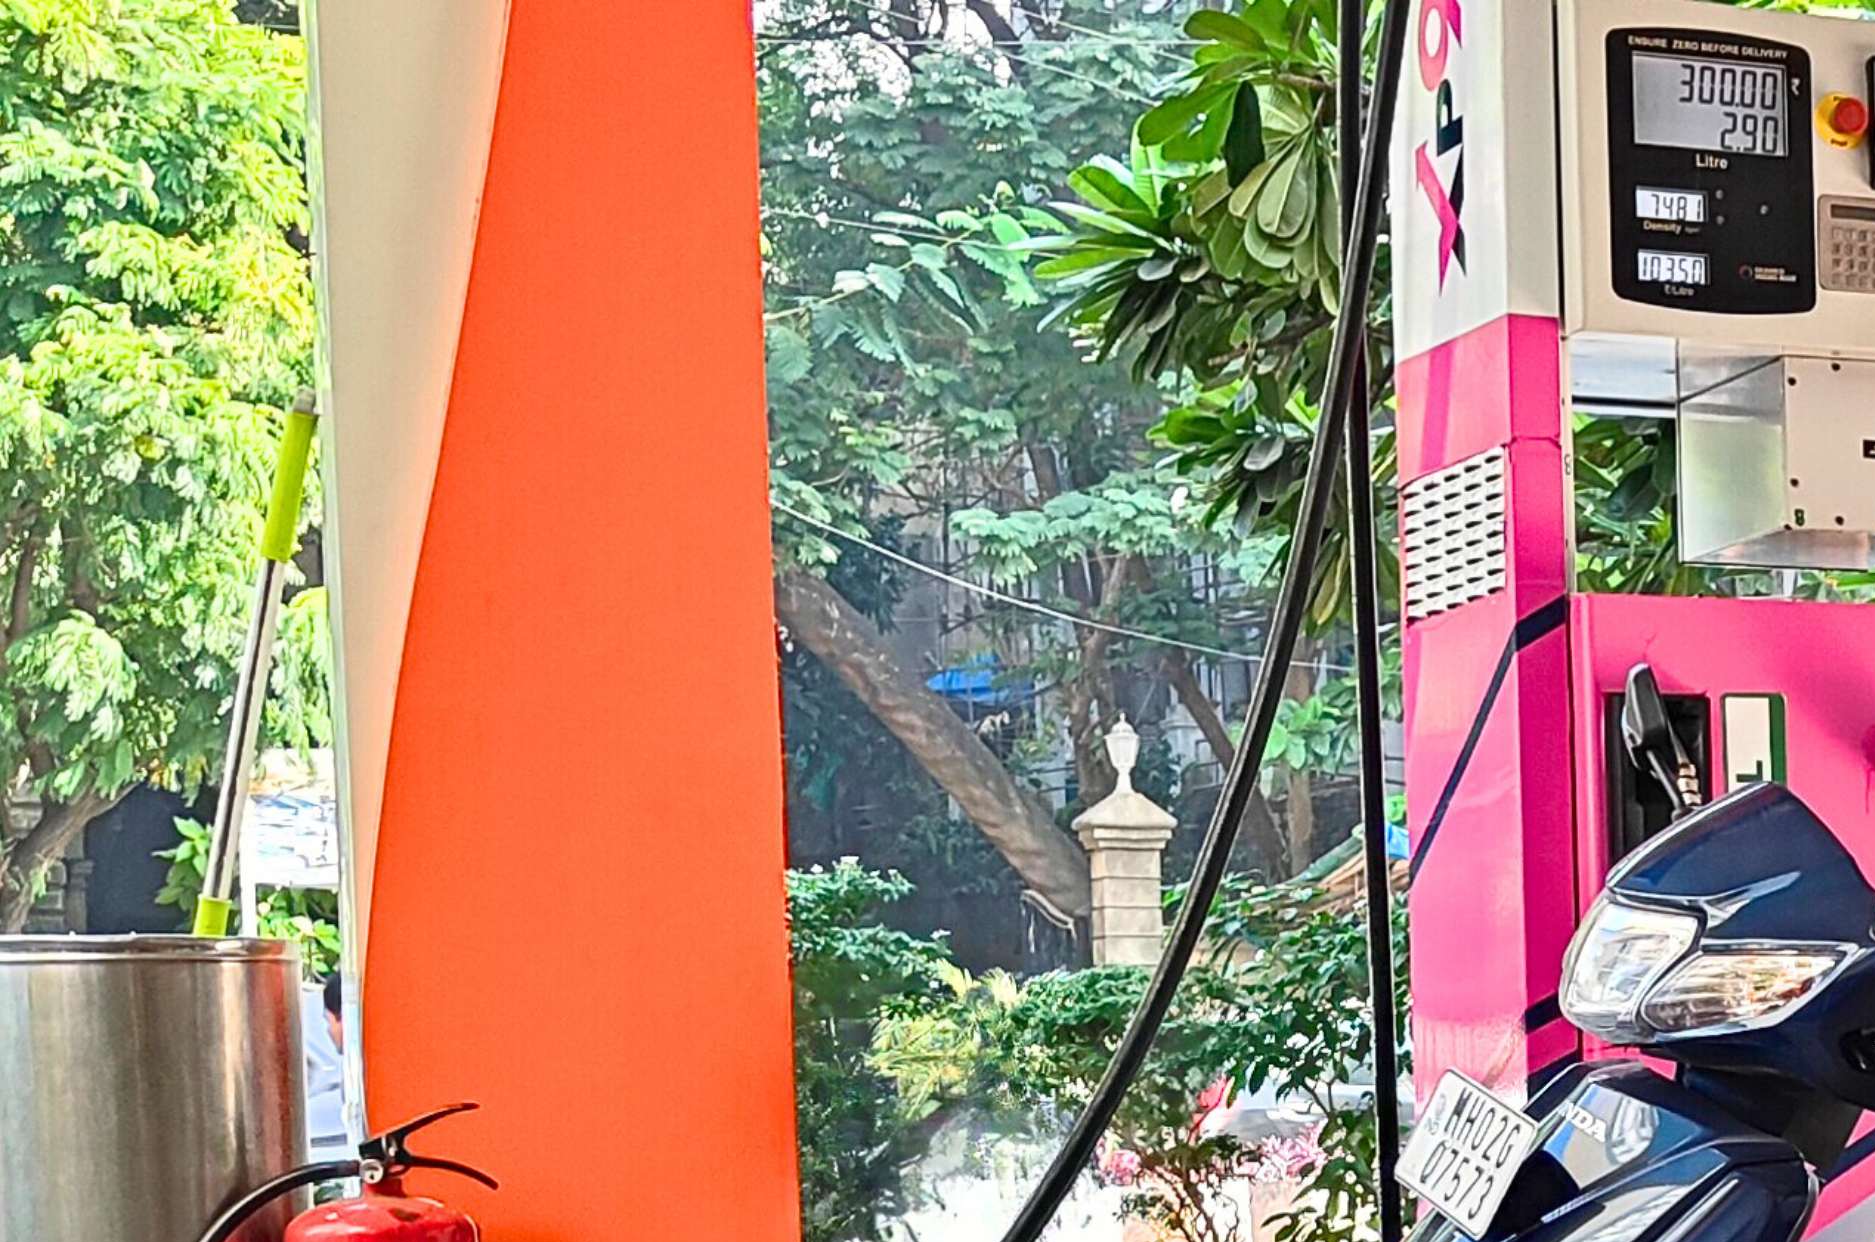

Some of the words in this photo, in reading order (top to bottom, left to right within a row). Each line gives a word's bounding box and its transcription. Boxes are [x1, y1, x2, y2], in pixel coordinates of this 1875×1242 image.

[1672, 39, 1699, 51] ZERO
[1701, 42, 1740, 55] BEFORE
[1741, 46, 1788, 59] DELIVERY
[1679, 63, 1778, 110] 300.00
[1720, 111, 1779, 153] 2.90
[1696, 153, 1728, 169] Litre
[1643, 220, 1682, 235] Density
[1444, 1086, 1521, 1169] MH02G
